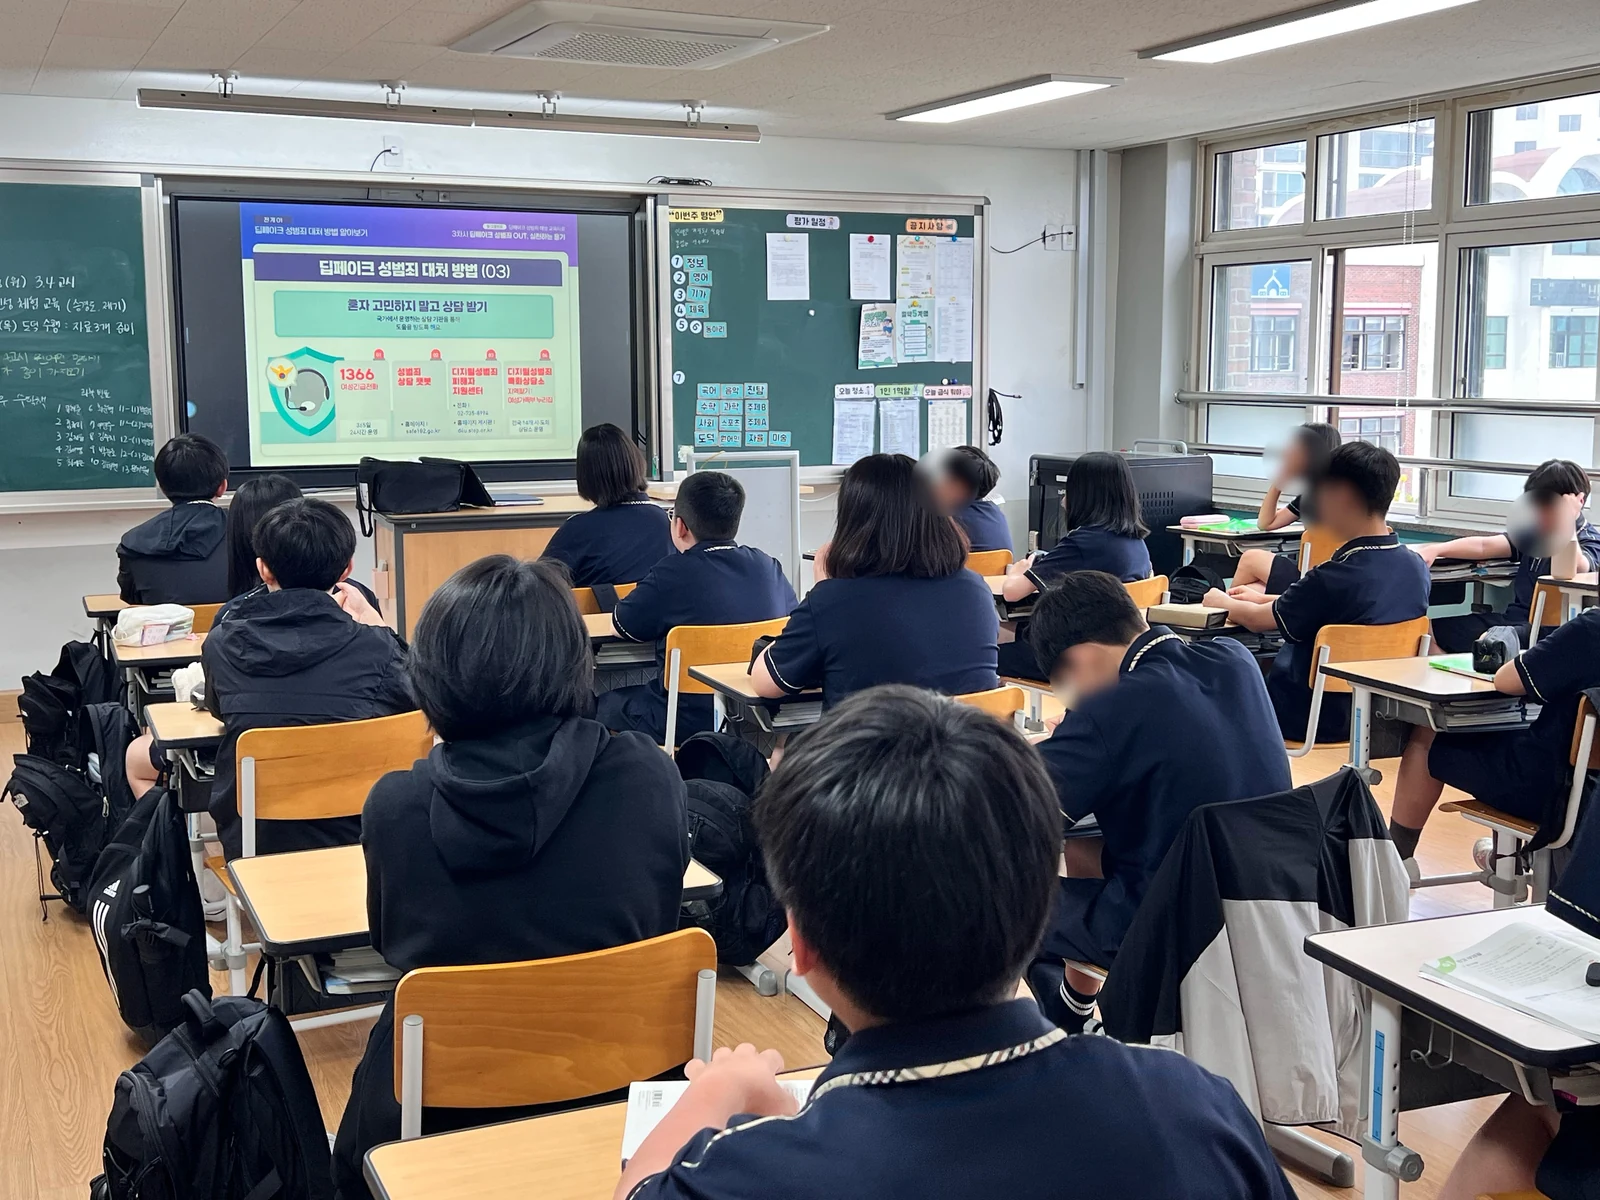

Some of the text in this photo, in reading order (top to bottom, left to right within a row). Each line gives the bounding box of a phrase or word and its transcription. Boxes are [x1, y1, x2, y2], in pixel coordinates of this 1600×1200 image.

[794, 217, 826, 227] 평가 일정
[910, 221, 943, 231] 공지사항
[255, 226, 284, 235] 딥페이크
[285, 226, 307, 236] 성범죄
[308, 227, 323, 236] 대처
[324, 228, 339, 237] 방법
[469, 231, 493, 239] 딥페이크
[494, 231, 512, 239] 성범죄
[686, 258, 704, 268] 정보
[319, 260, 511, 279] 딥페이크 성범죄 대처 방법 (03)
[58, 275, 75, 288] 교시
[692, 272, 708, 282] 영어
[691, 288, 707, 299] 기가
[17, 296, 39, 310] 체험
[43, 297, 61, 311] 교육
[348, 298, 488, 313] 혼자 고민하지 말고 상담 받기
[22, 320, 39, 333] 도덕
[42, 318, 61, 334] 수행
[340, 368, 375, 381] 1366
[397, 367, 422, 377] 성범죄
[451, 367, 498, 376] 디지털성범죄
[507, 367, 553, 376] 디지털성범죄
[397, 377, 414, 386] 상담
[452, 387, 484, 395] 지원센터
[702, 386, 717, 394] 국어
[725, 386, 739, 395] 음악
[880, 388, 911, 396] 1인 1역할
[700, 402, 716, 411] 수학
[724, 402, 739, 411] 과학
[698, 418, 715, 427] 사회
[721, 419, 740, 427] 스포츠
[698, 433, 715, 443] 도덕
[772, 433, 787, 442] 미술
